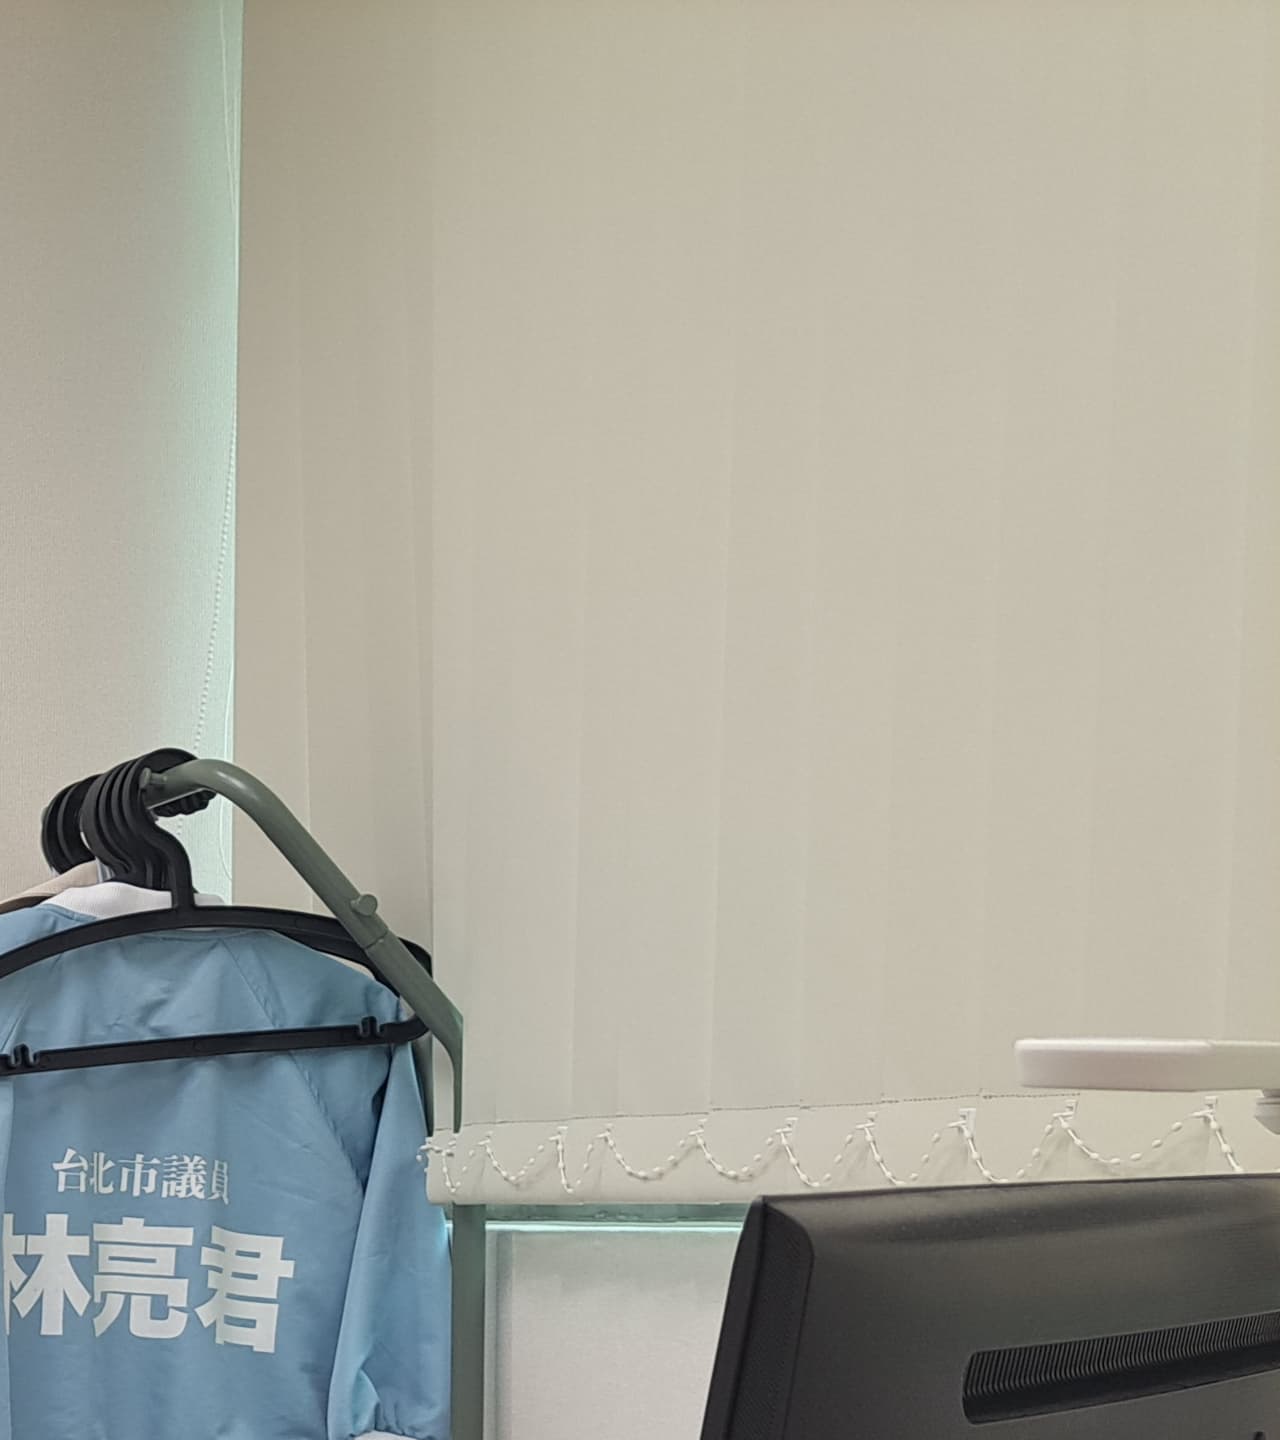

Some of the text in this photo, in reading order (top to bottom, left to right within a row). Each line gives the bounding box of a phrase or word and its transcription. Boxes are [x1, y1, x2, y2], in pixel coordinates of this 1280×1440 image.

[52, 1147, 230, 1205] 台北市議員
[2, 1213, 295, 1353] 林亮君
